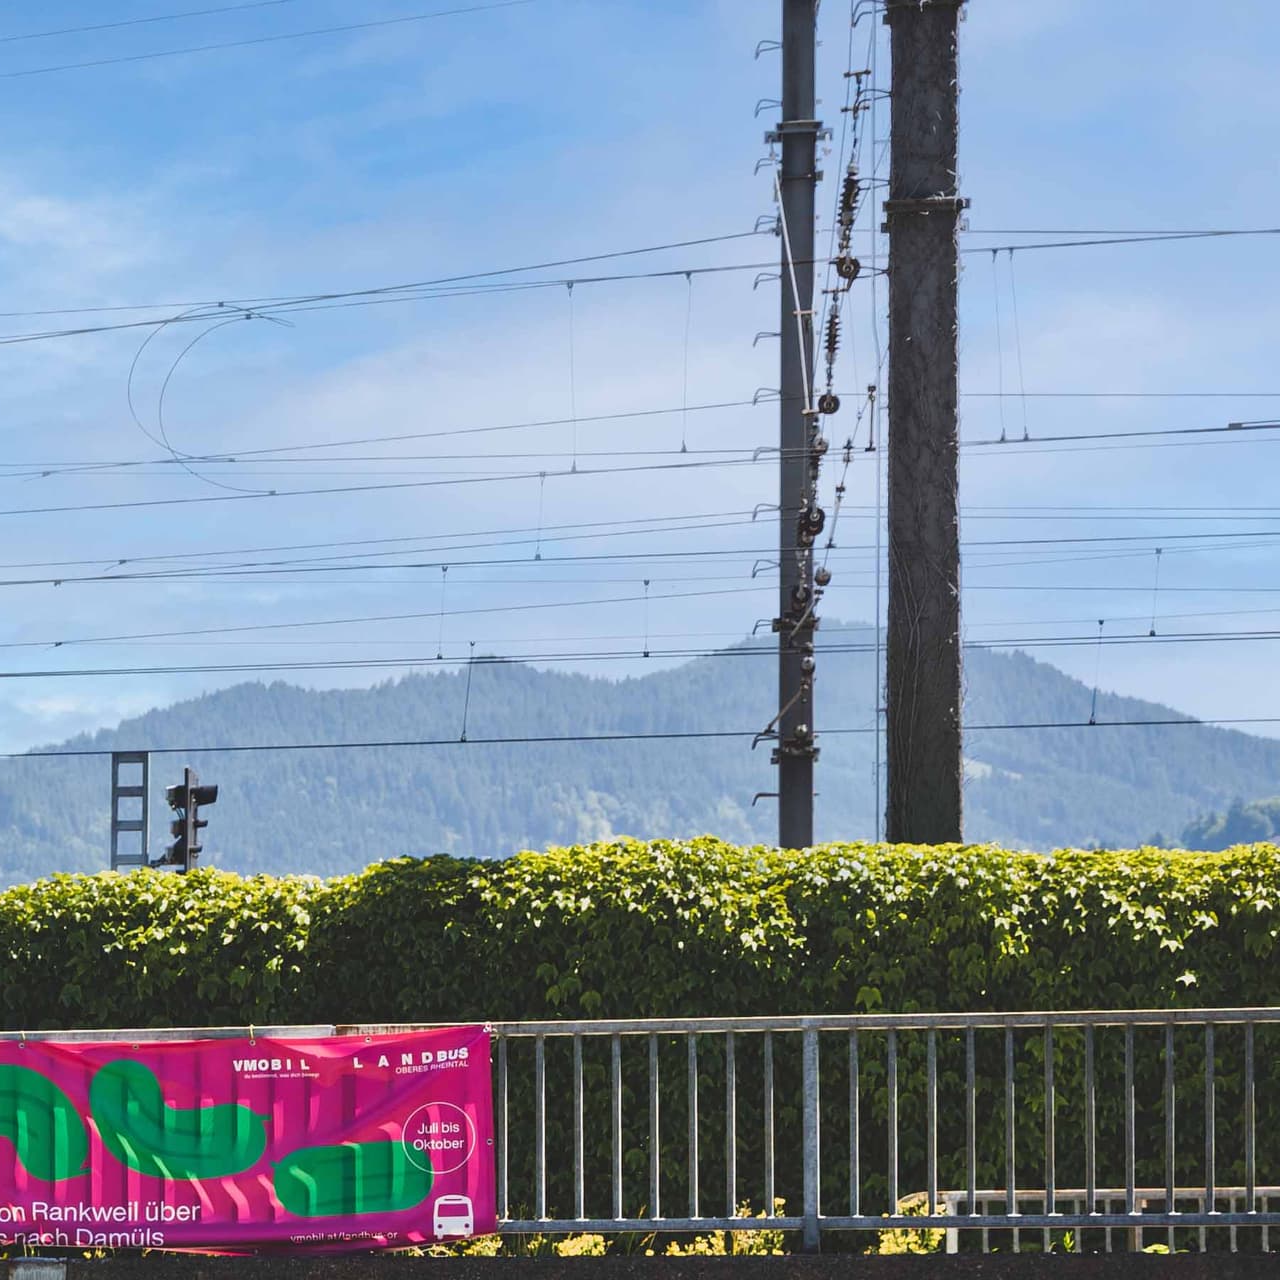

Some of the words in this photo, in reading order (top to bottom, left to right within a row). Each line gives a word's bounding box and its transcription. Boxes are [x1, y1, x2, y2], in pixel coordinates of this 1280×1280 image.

[233, 1059, 310, 1072] VMOBIL
[353, 1046, 469, 1069] LANDBUS
[395, 1064, 429, 1075] OBERES
[430, 1059, 469, 1071] RHEINTAL
[417, 1122, 439, 1135] Juli
[441, 1121, 460, 1133] bis
[413, 1138, 465, 1151] Oktober
[31, 1201, 139, 1222] Rankweil
[145, 1201, 201, 1222] über
[14, 1228, 69, 1246] nach
[76, 1227, 165, 1247] Damüls
